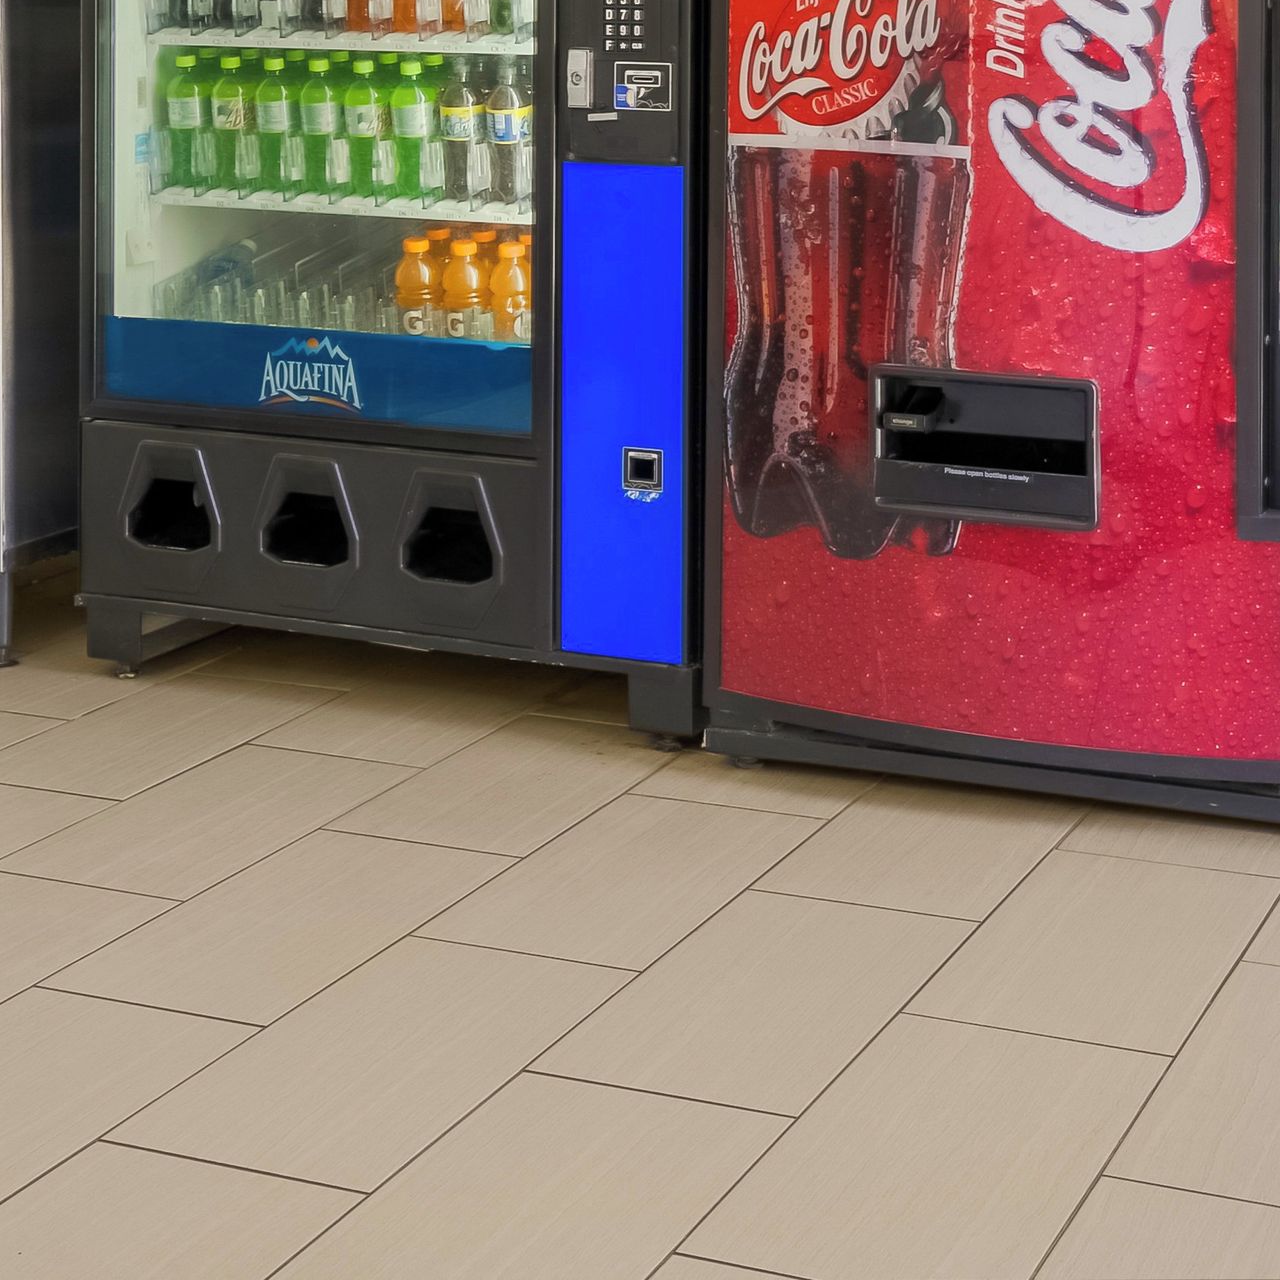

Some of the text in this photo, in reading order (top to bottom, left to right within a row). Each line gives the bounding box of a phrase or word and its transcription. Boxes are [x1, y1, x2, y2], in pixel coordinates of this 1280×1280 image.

[811, 78, 878, 117] CLASSIC
[403, 310, 426, 335] G
[447, 312, 464, 337] G
[259, 351, 361, 409] AQUAFINA
[944, 467, 966, 475] Please
[984, 471, 1007, 480] bottles
[1008, 474, 1029, 483] slowly
